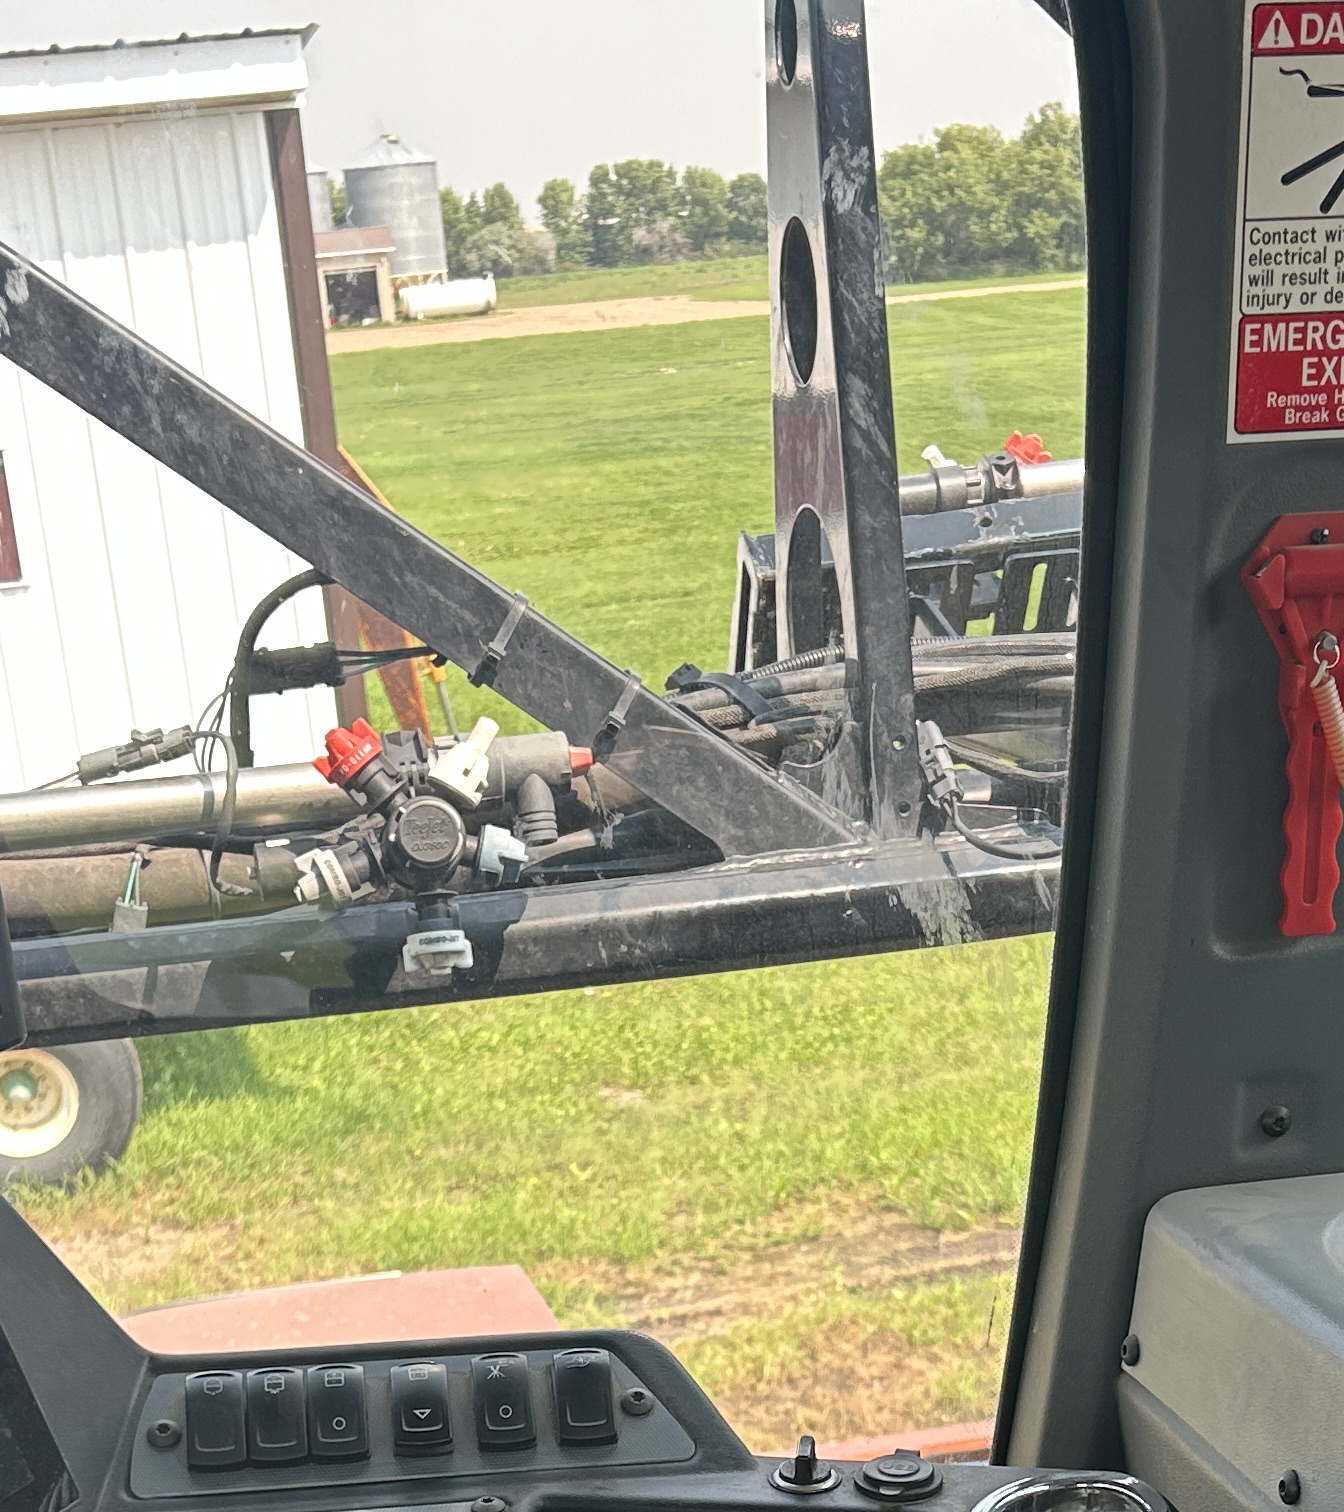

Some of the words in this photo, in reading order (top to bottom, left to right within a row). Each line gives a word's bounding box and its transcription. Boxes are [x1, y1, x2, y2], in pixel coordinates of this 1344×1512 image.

[1250, 227, 1316, 245] Contact
[1249, 246, 1327, 266] electrical
[1248, 269, 1273, 287] will
[1282, 267, 1329, 286] result
[1247, 289, 1292, 310] injury
[1300, 292, 1317, 305] or
[1267, 392, 1327, 407] Remove
[1285, 407, 1329, 424] Break
